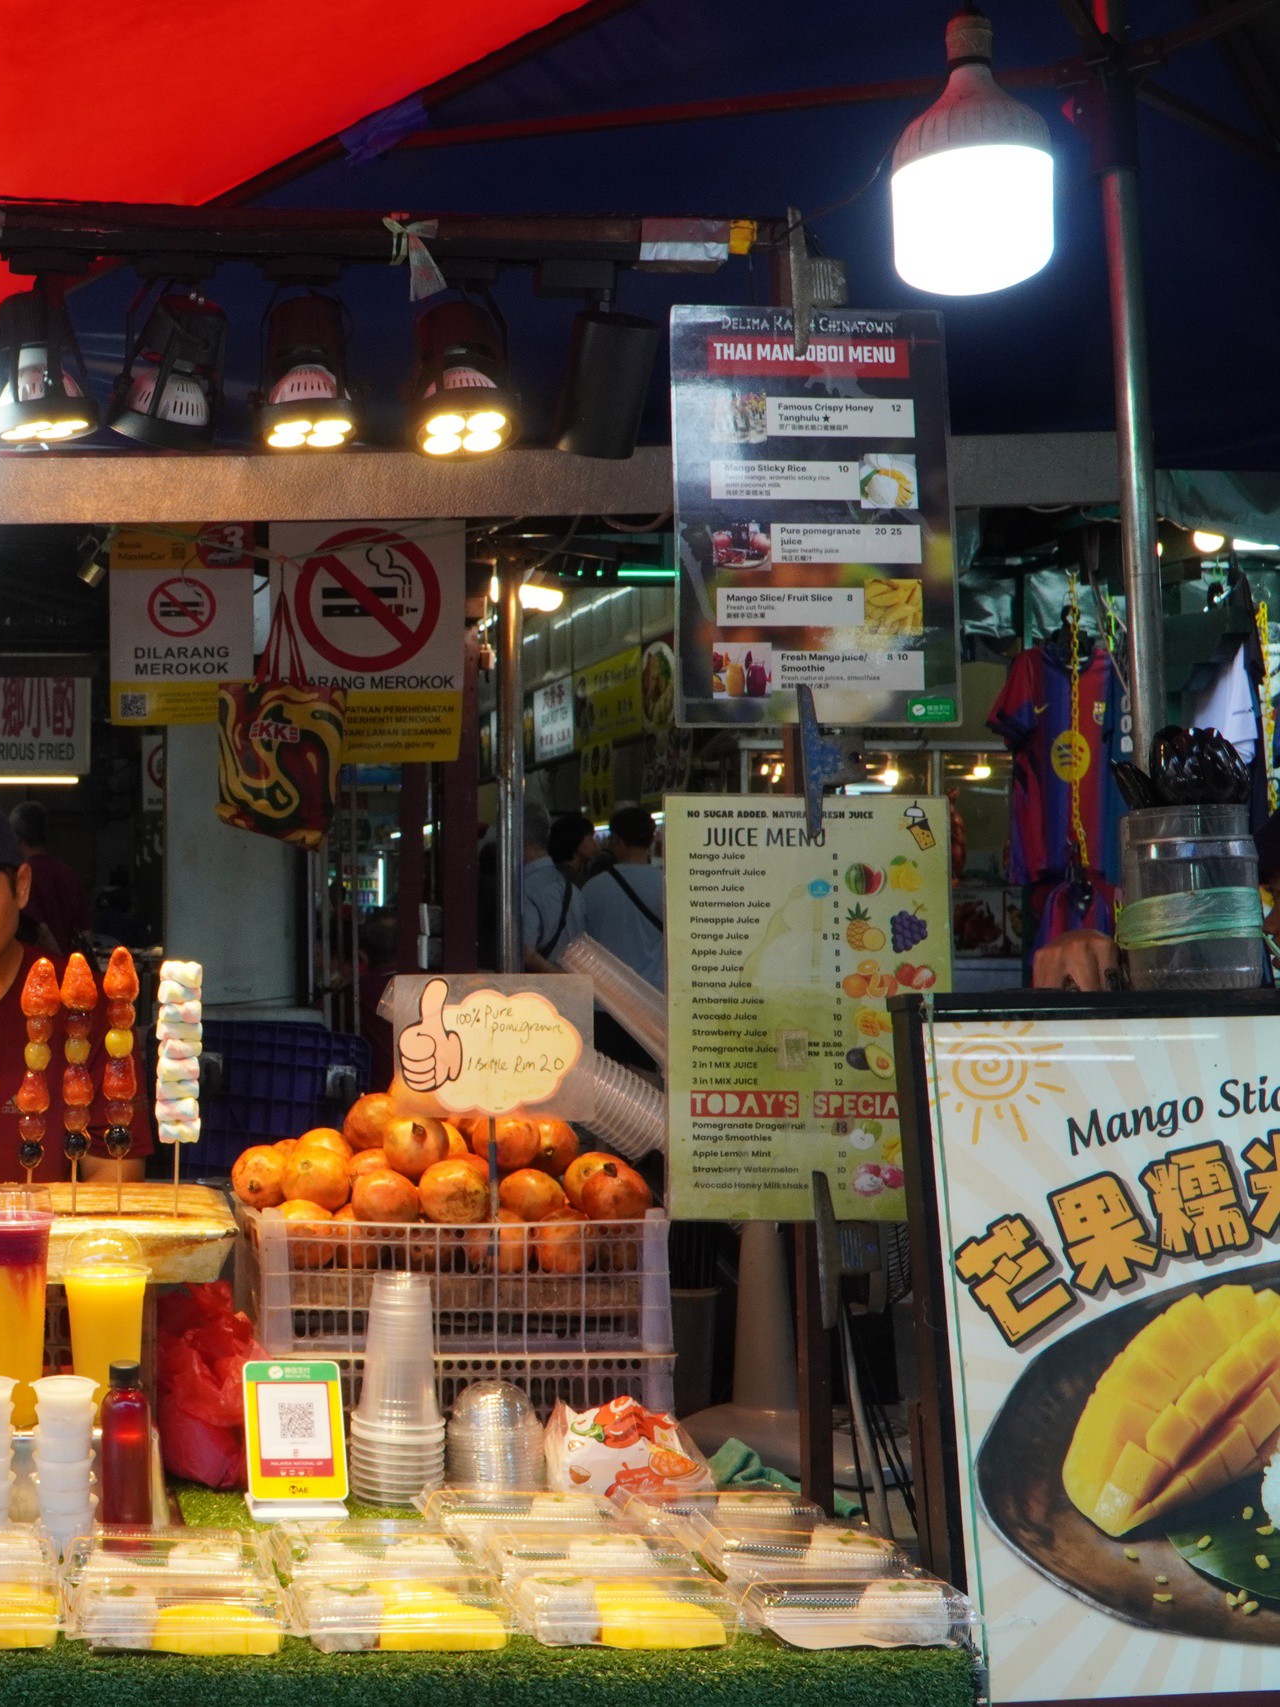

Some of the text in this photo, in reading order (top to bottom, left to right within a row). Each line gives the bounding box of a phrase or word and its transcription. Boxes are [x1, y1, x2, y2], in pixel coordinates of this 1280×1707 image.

[714, 343, 752, 360] THAI
[848, 346, 895, 363] MENU
[815, 404, 843, 413] Crispy
[846, 404, 873, 413] Honey
[779, 414, 819, 423] Tanghulu
[758, 464, 785, 473] Sticky
[781, 527, 800, 535] Pure
[803, 528, 860, 536] pomegranate
[781, 538, 802, 546] juice
[727, 594, 758, 603] Mango
[760, 594, 786, 602] Slice/
[134, 646, 229, 659] DILARANG
[809, 654, 840, 662] Mango
[842, 654, 867, 662] juice/
[135, 662, 228, 675] MEROKOK
[781, 664, 825, 672] Smoothie
[281, 675, 454, 689] ARANG MEROKOK
[259, 722, 288, 740] KK
[39, 742, 75, 760] FRIED
[688, 810, 700, 818] NO
[704, 810, 734, 818] SUGAR
[737, 810, 768, 818] ADDED.
[849, 811, 873, 819] JUICE
[703, 828, 757, 846] JUICE
[689, 853, 720, 861] Mango
[722, 852, 745, 860] Juice
[690, 868, 740, 878] Dragonfruit
[742, 868, 766, 876] Juice
[721, 884, 744, 892] Juice
[456, 1008, 481, 1027] 100%
[692, 1045, 778, 1054] Pomegranate Juice
[540, 1054, 564, 1071] 20
[693, 1093, 899, 1115] TODAY'S SPECIA
[1066, 1094, 1204, 1156] Mango
[693, 1134, 723, 1143] Mango
[734, 1182, 762, 1191] Honey
